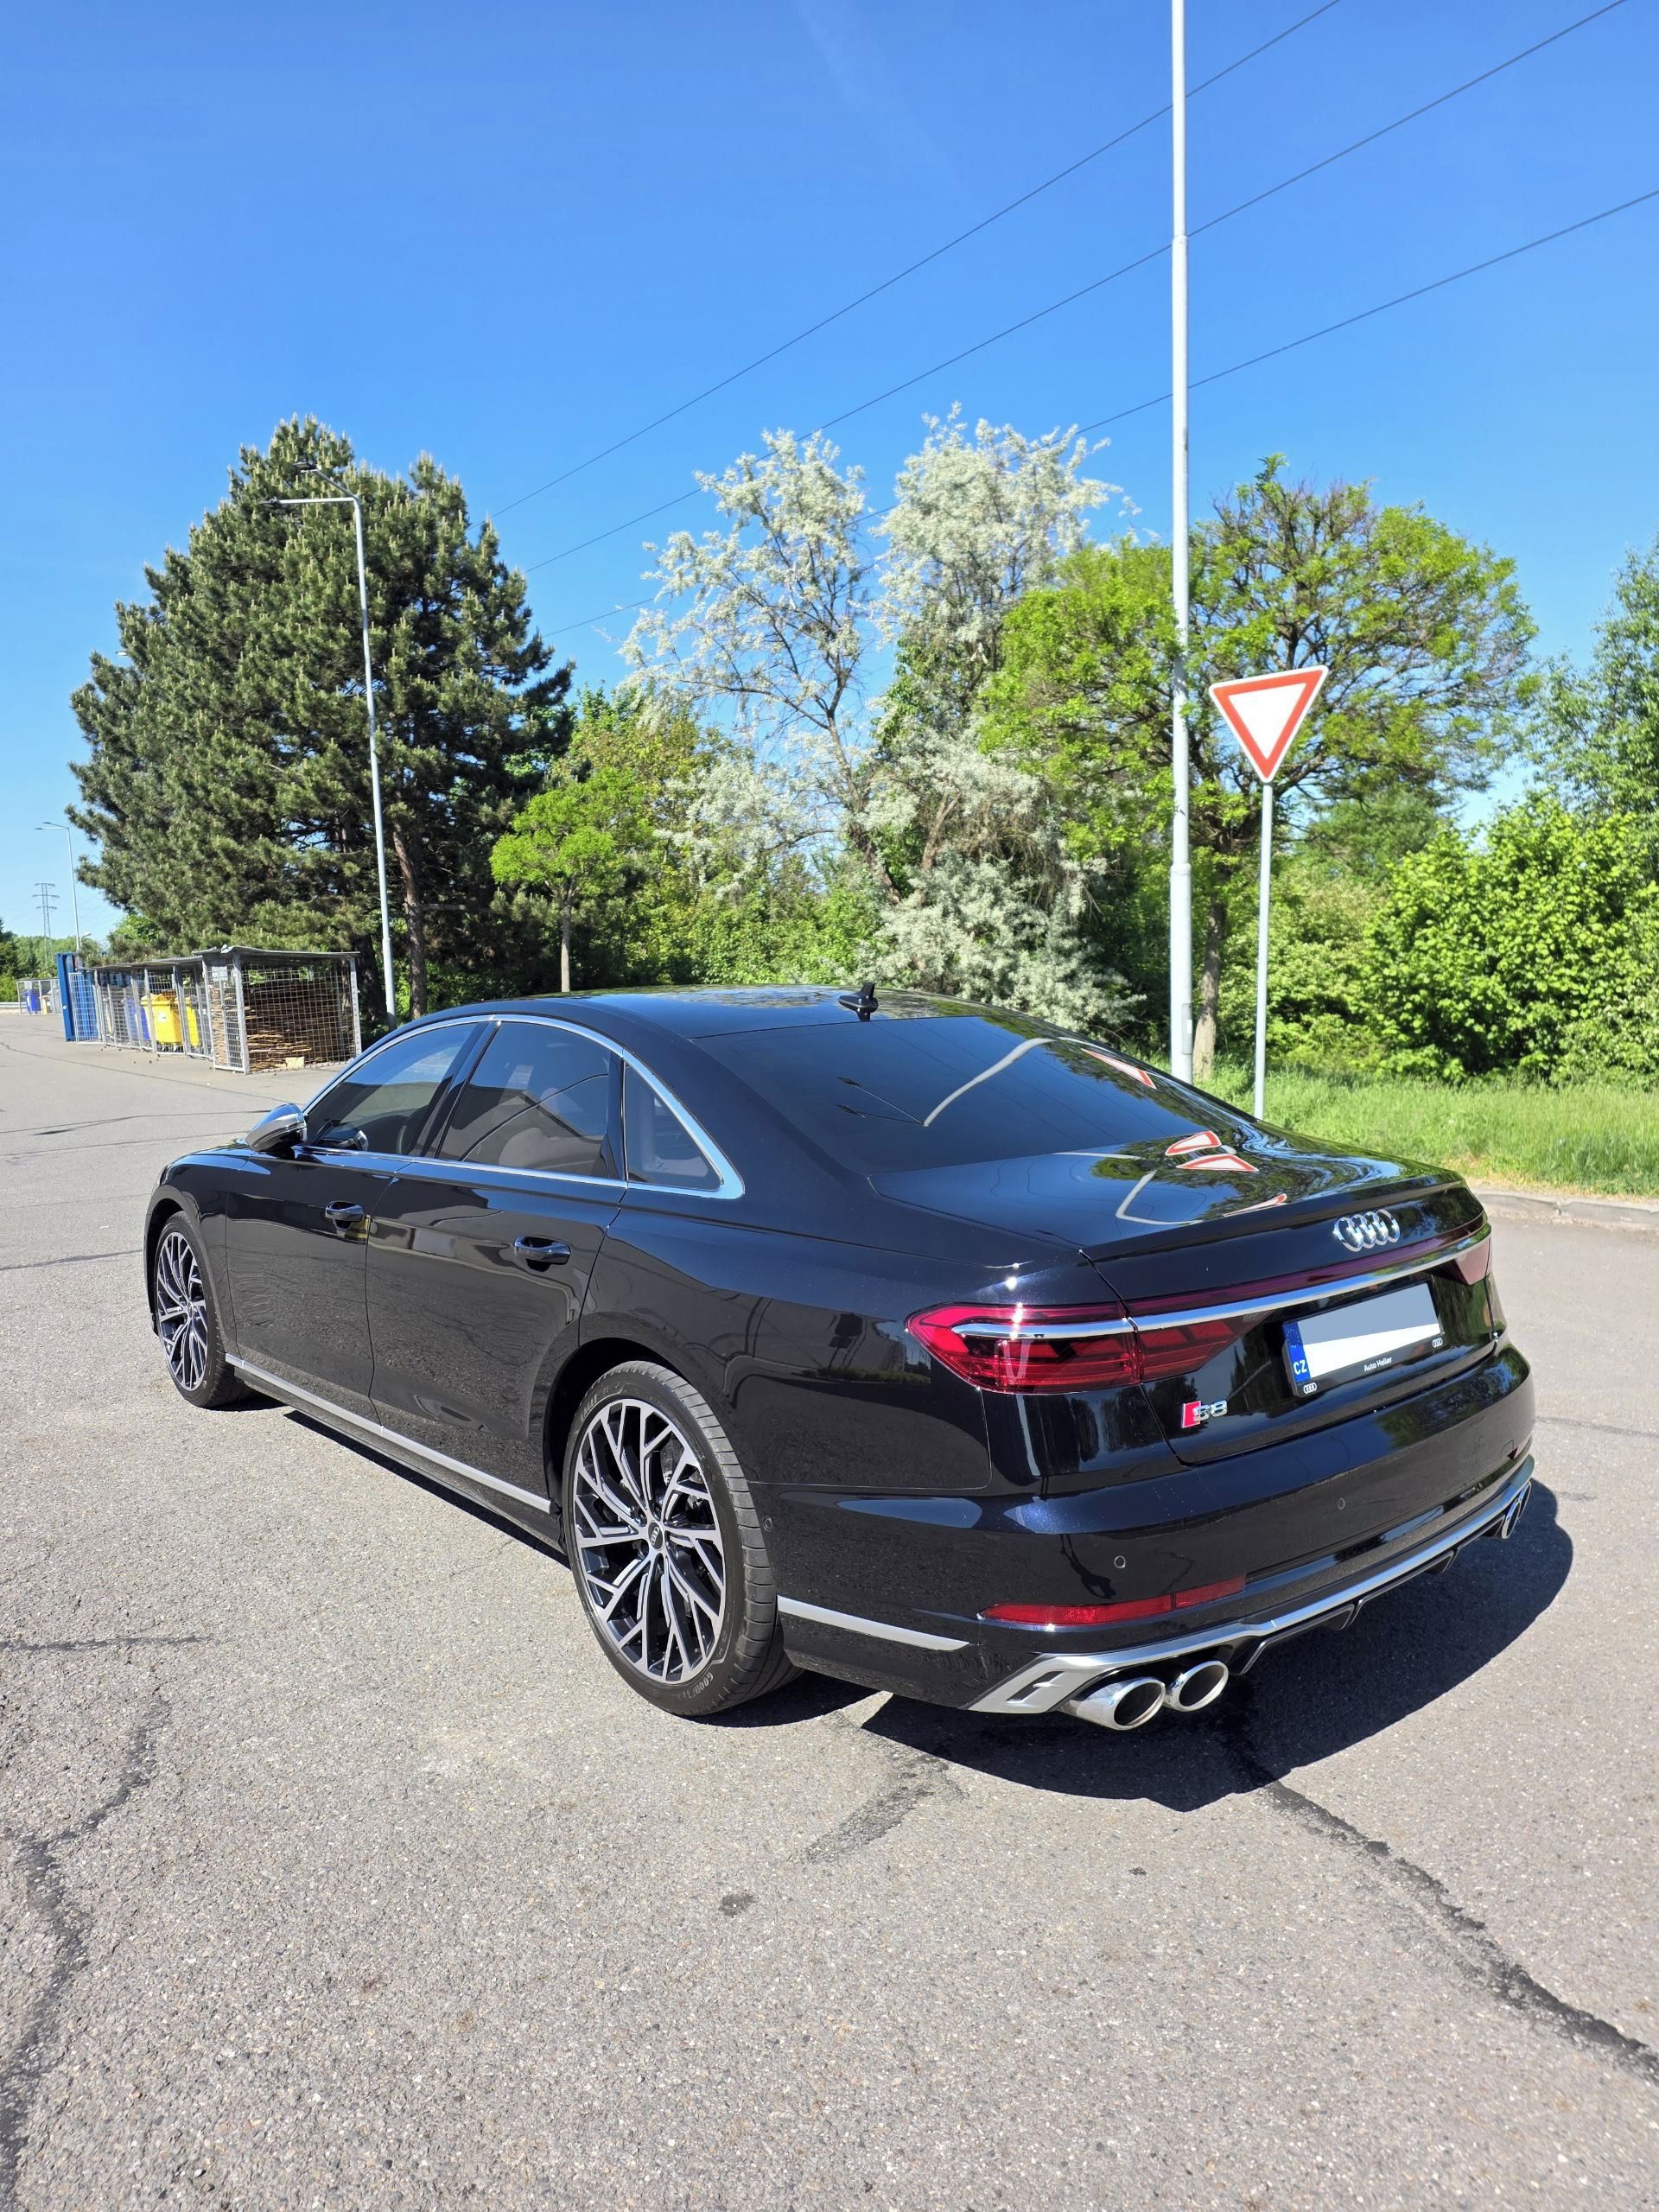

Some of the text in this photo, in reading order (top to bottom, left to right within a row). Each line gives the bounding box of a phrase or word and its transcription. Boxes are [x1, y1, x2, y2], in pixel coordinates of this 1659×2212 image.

[1294, 1359, 1307, 1375] CZ
[1363, 1362, 1376, 1372] Auto
[1192, 1400, 1227, 1421] S8
